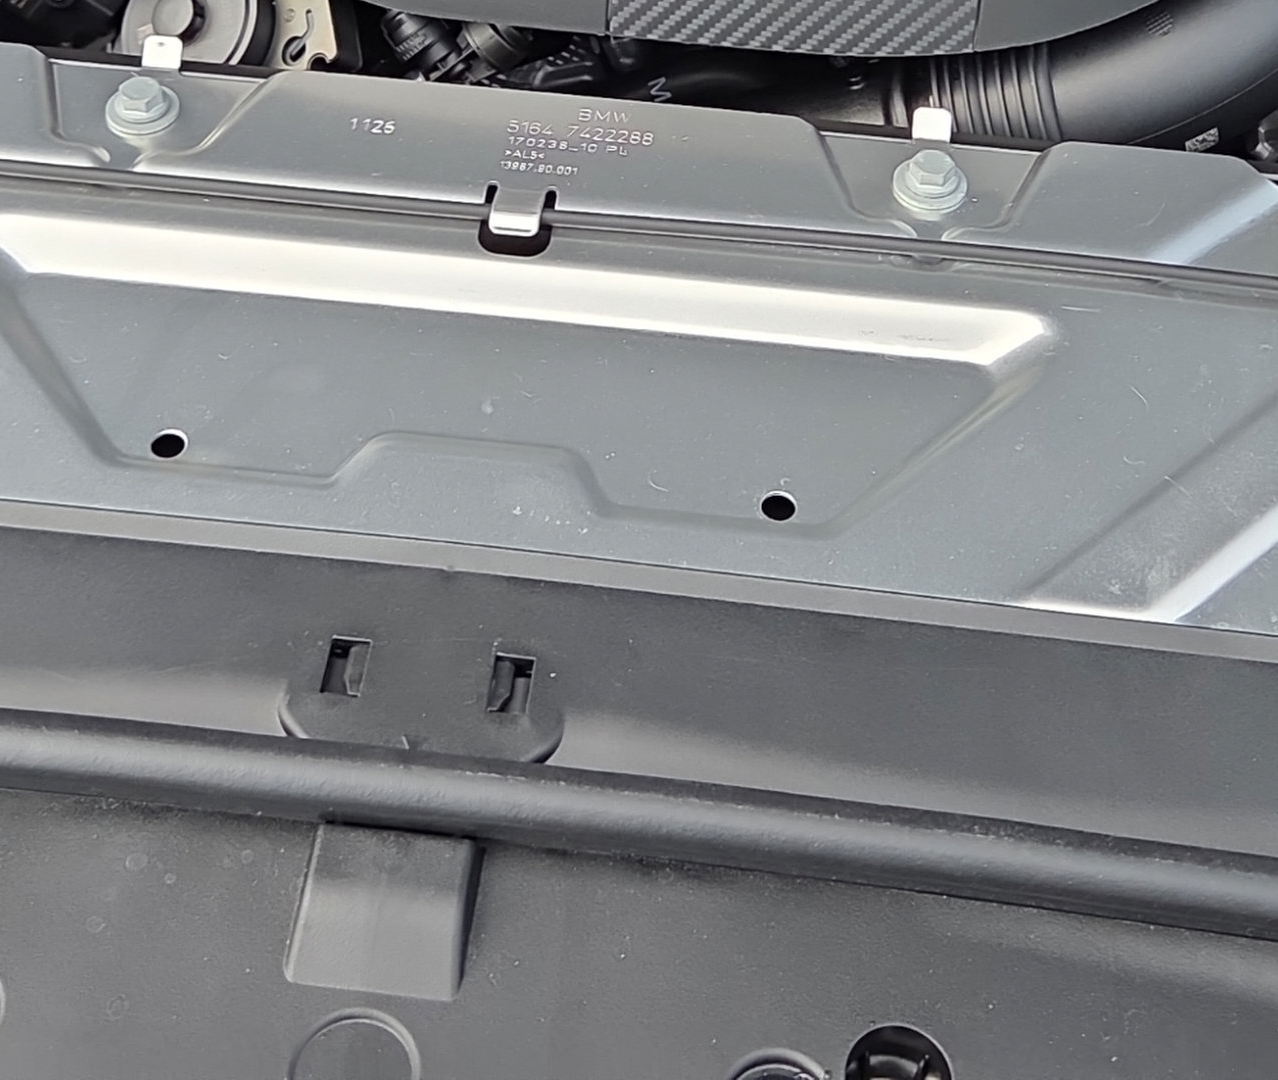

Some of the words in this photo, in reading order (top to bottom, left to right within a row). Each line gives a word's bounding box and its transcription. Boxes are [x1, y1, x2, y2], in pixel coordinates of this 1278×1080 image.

[578, 108, 631, 123] BMW
[506, 119, 553, 136] 5164
[567, 125, 654, 146] 7422288
